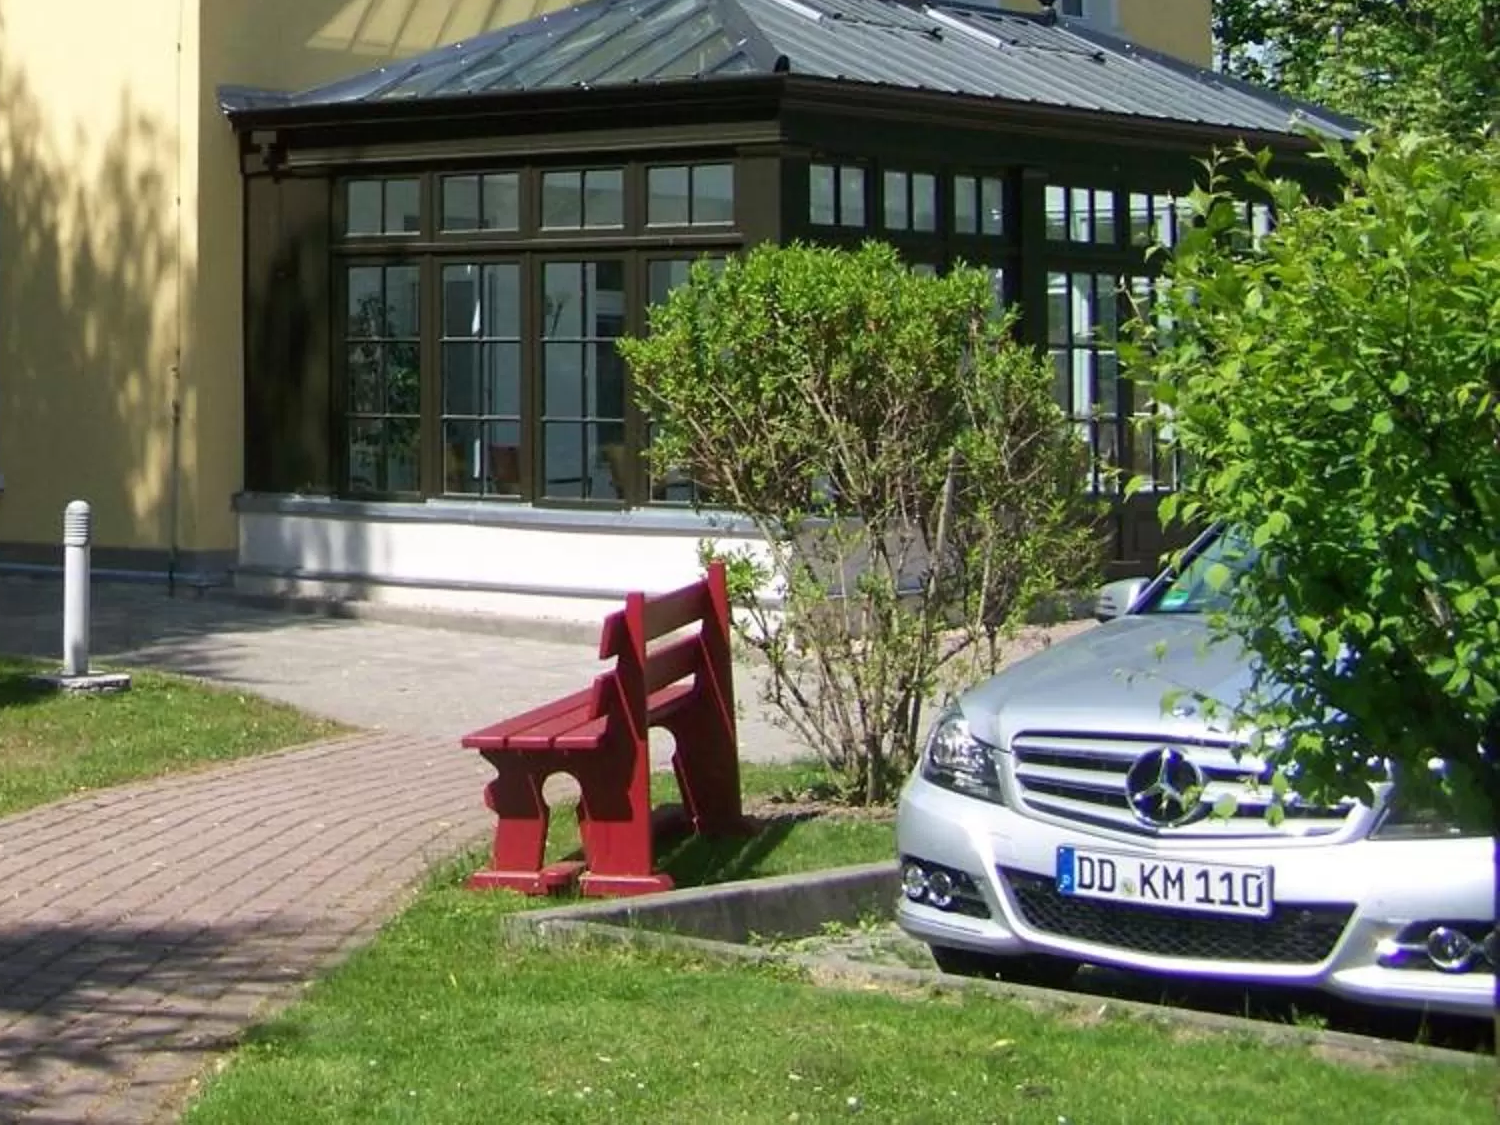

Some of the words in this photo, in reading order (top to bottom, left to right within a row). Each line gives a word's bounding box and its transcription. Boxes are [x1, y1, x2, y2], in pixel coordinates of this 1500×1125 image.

[1076, 855, 1117, 893] DD
[1139, 862, 1185, 902] KM
[1195, 869, 1263, 909] 110
